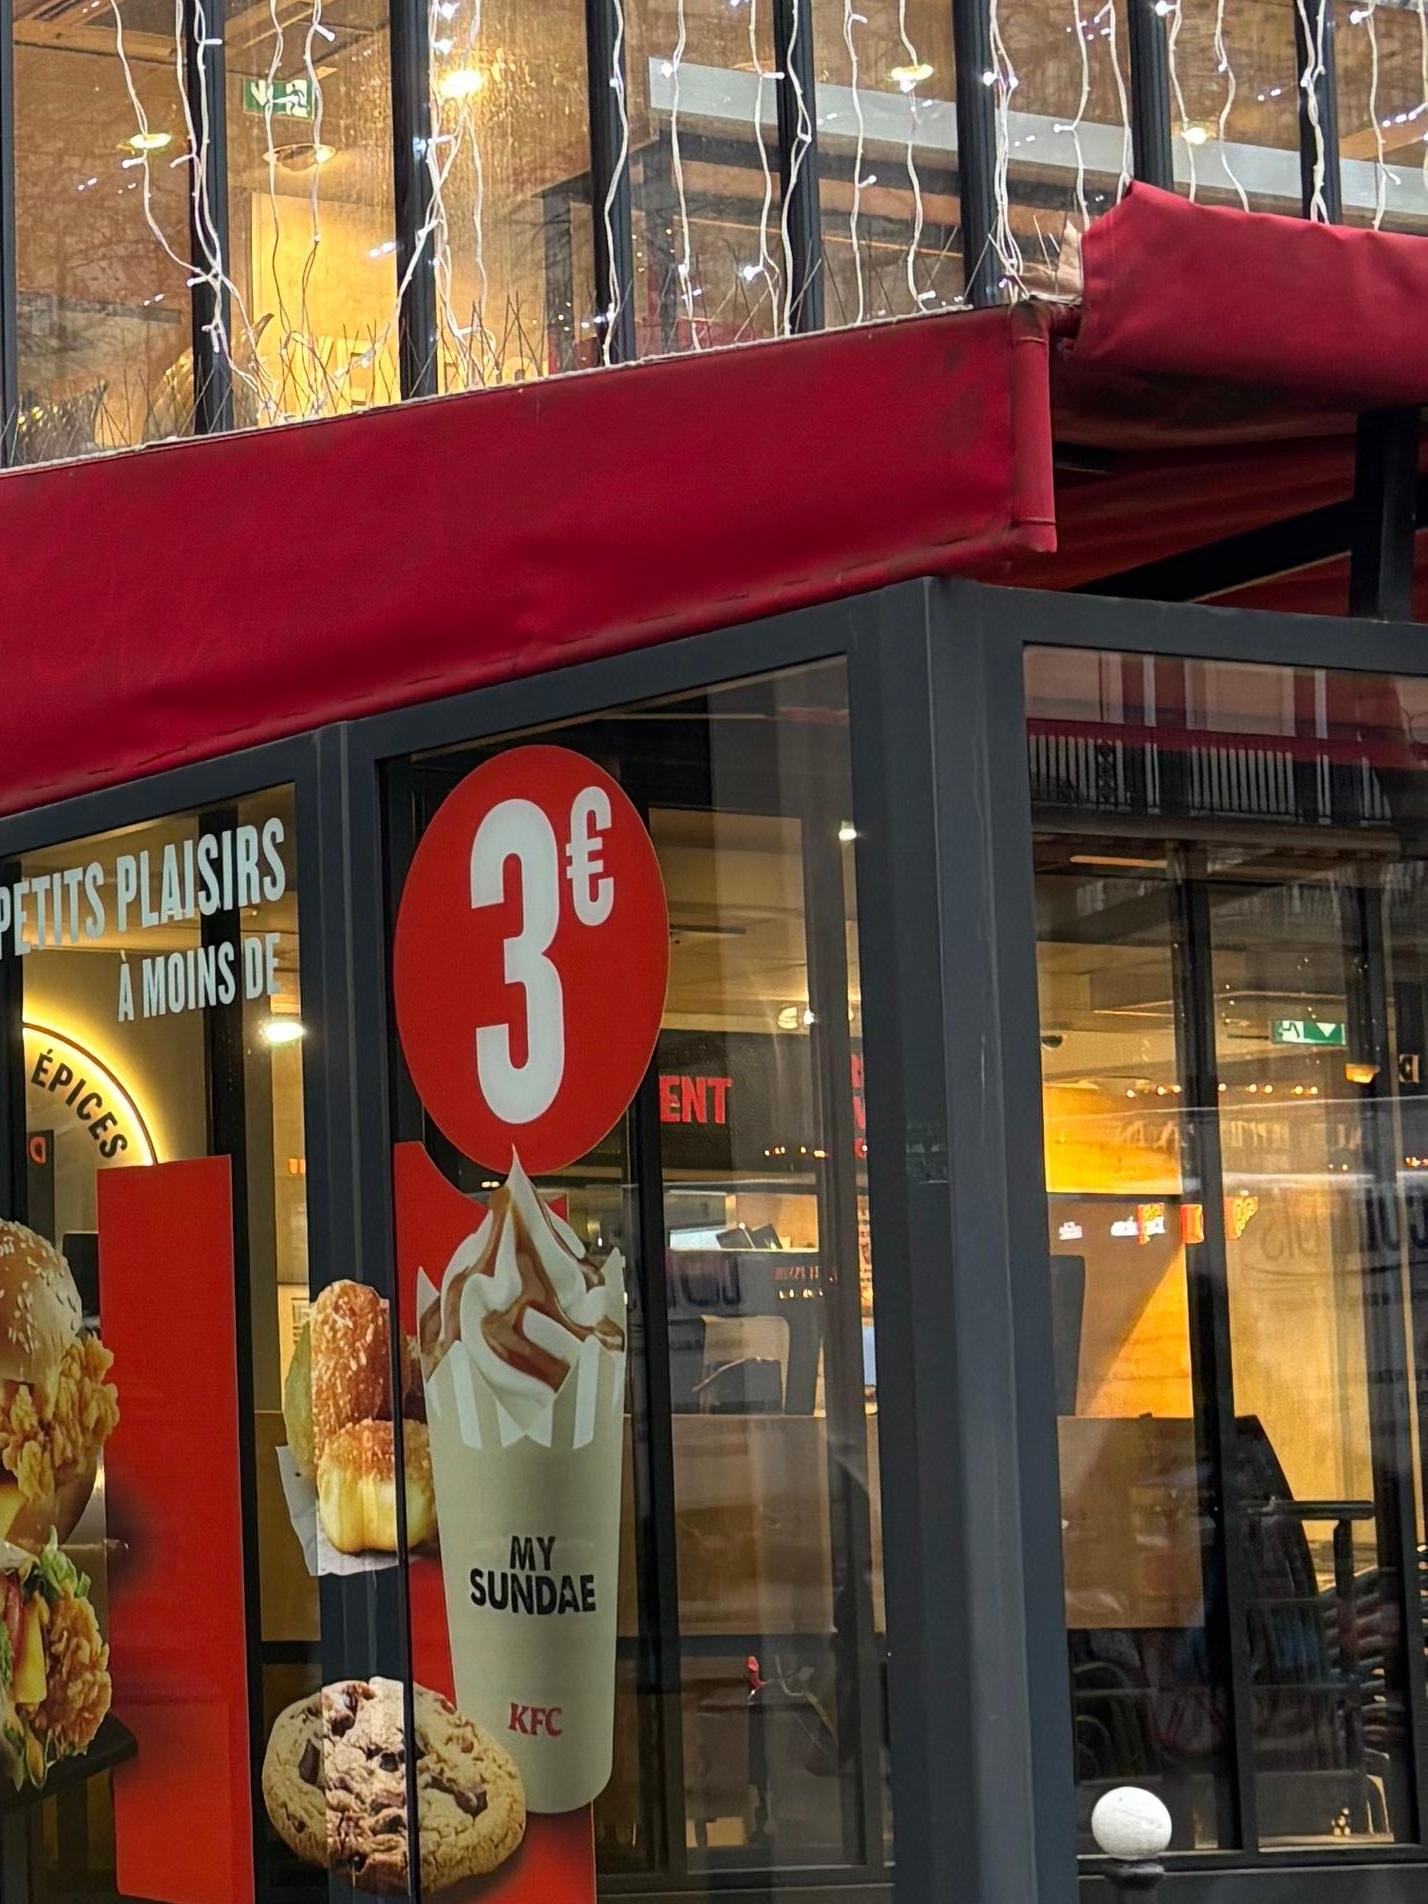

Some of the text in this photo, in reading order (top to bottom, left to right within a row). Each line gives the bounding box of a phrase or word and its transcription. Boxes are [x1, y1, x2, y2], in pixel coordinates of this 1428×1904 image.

[115, 816, 287, 933] PLAISIRS
[117, 932, 282, 1023] À MOINS DE
[30, 1048, 128, 1160] ÉPICES
[508, 1533, 557, 1573] MY
[469, 1565, 598, 1614] SUNDAE
[507, 1699, 564, 1738] KFC
